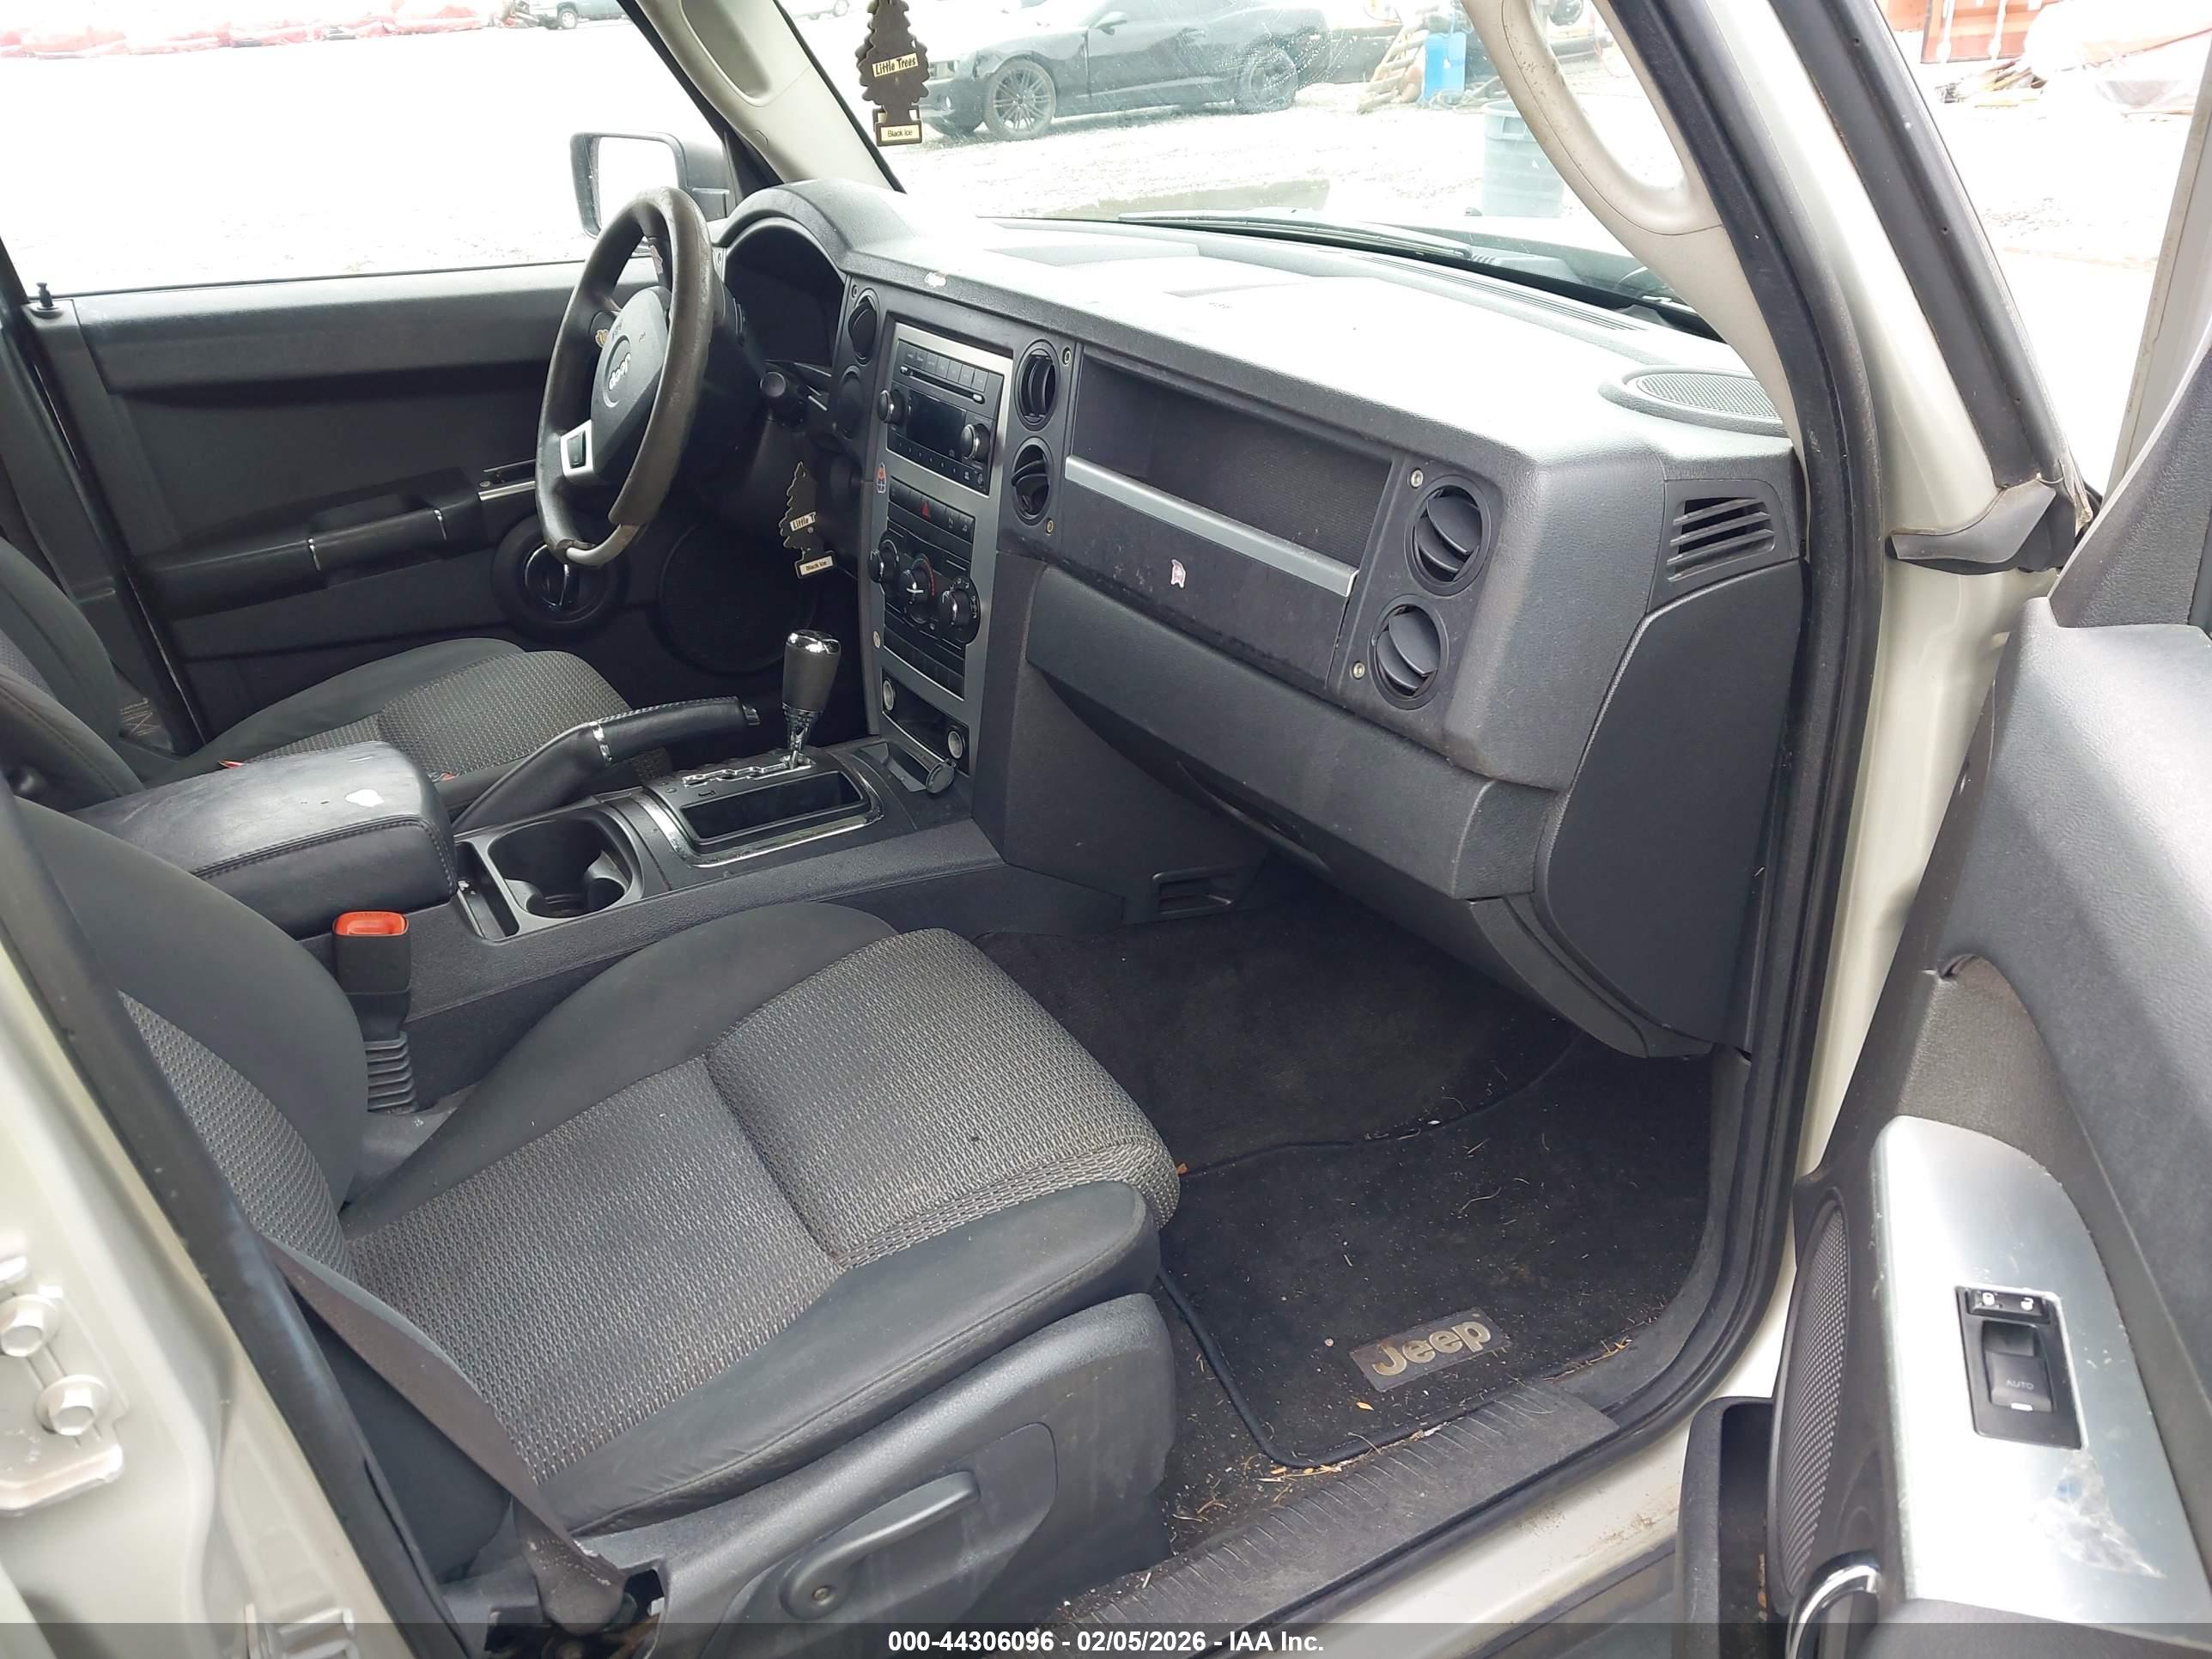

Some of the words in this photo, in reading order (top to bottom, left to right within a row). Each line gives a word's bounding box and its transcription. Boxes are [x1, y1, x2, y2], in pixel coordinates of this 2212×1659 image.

[875, 60, 896, 75] Little
[896, 58, 916, 69] Trees
[887, 129, 903, 137] Black
[1372, 1321, 1492, 1376] Jeep
[2006, 1378, 2034, 1390] AUTO
